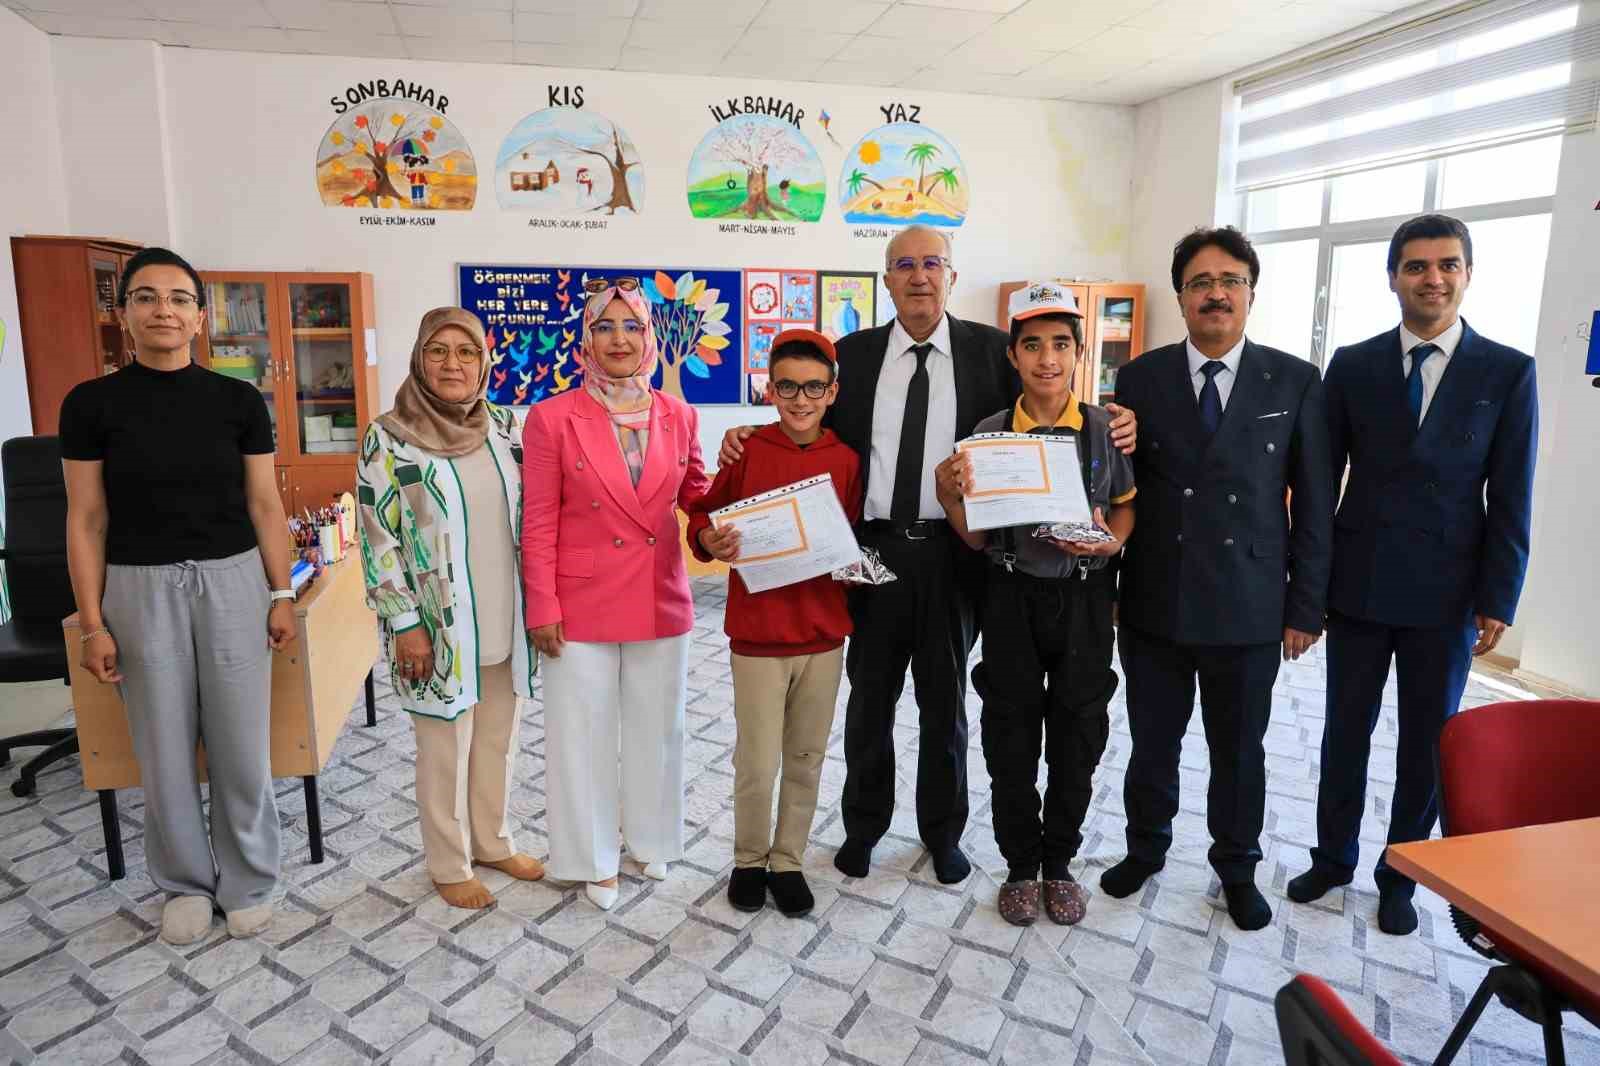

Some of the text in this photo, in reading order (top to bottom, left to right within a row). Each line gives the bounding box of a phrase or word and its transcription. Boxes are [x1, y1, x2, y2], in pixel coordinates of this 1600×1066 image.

[330, 79, 449, 114] SONBAHAR
[708, 96, 805, 130] İLKBAHAR
[880, 103, 921, 123] YAZ
[474, 269, 551, 284] ÖĞRENMEK
[476, 299, 550, 311] HER YERE
